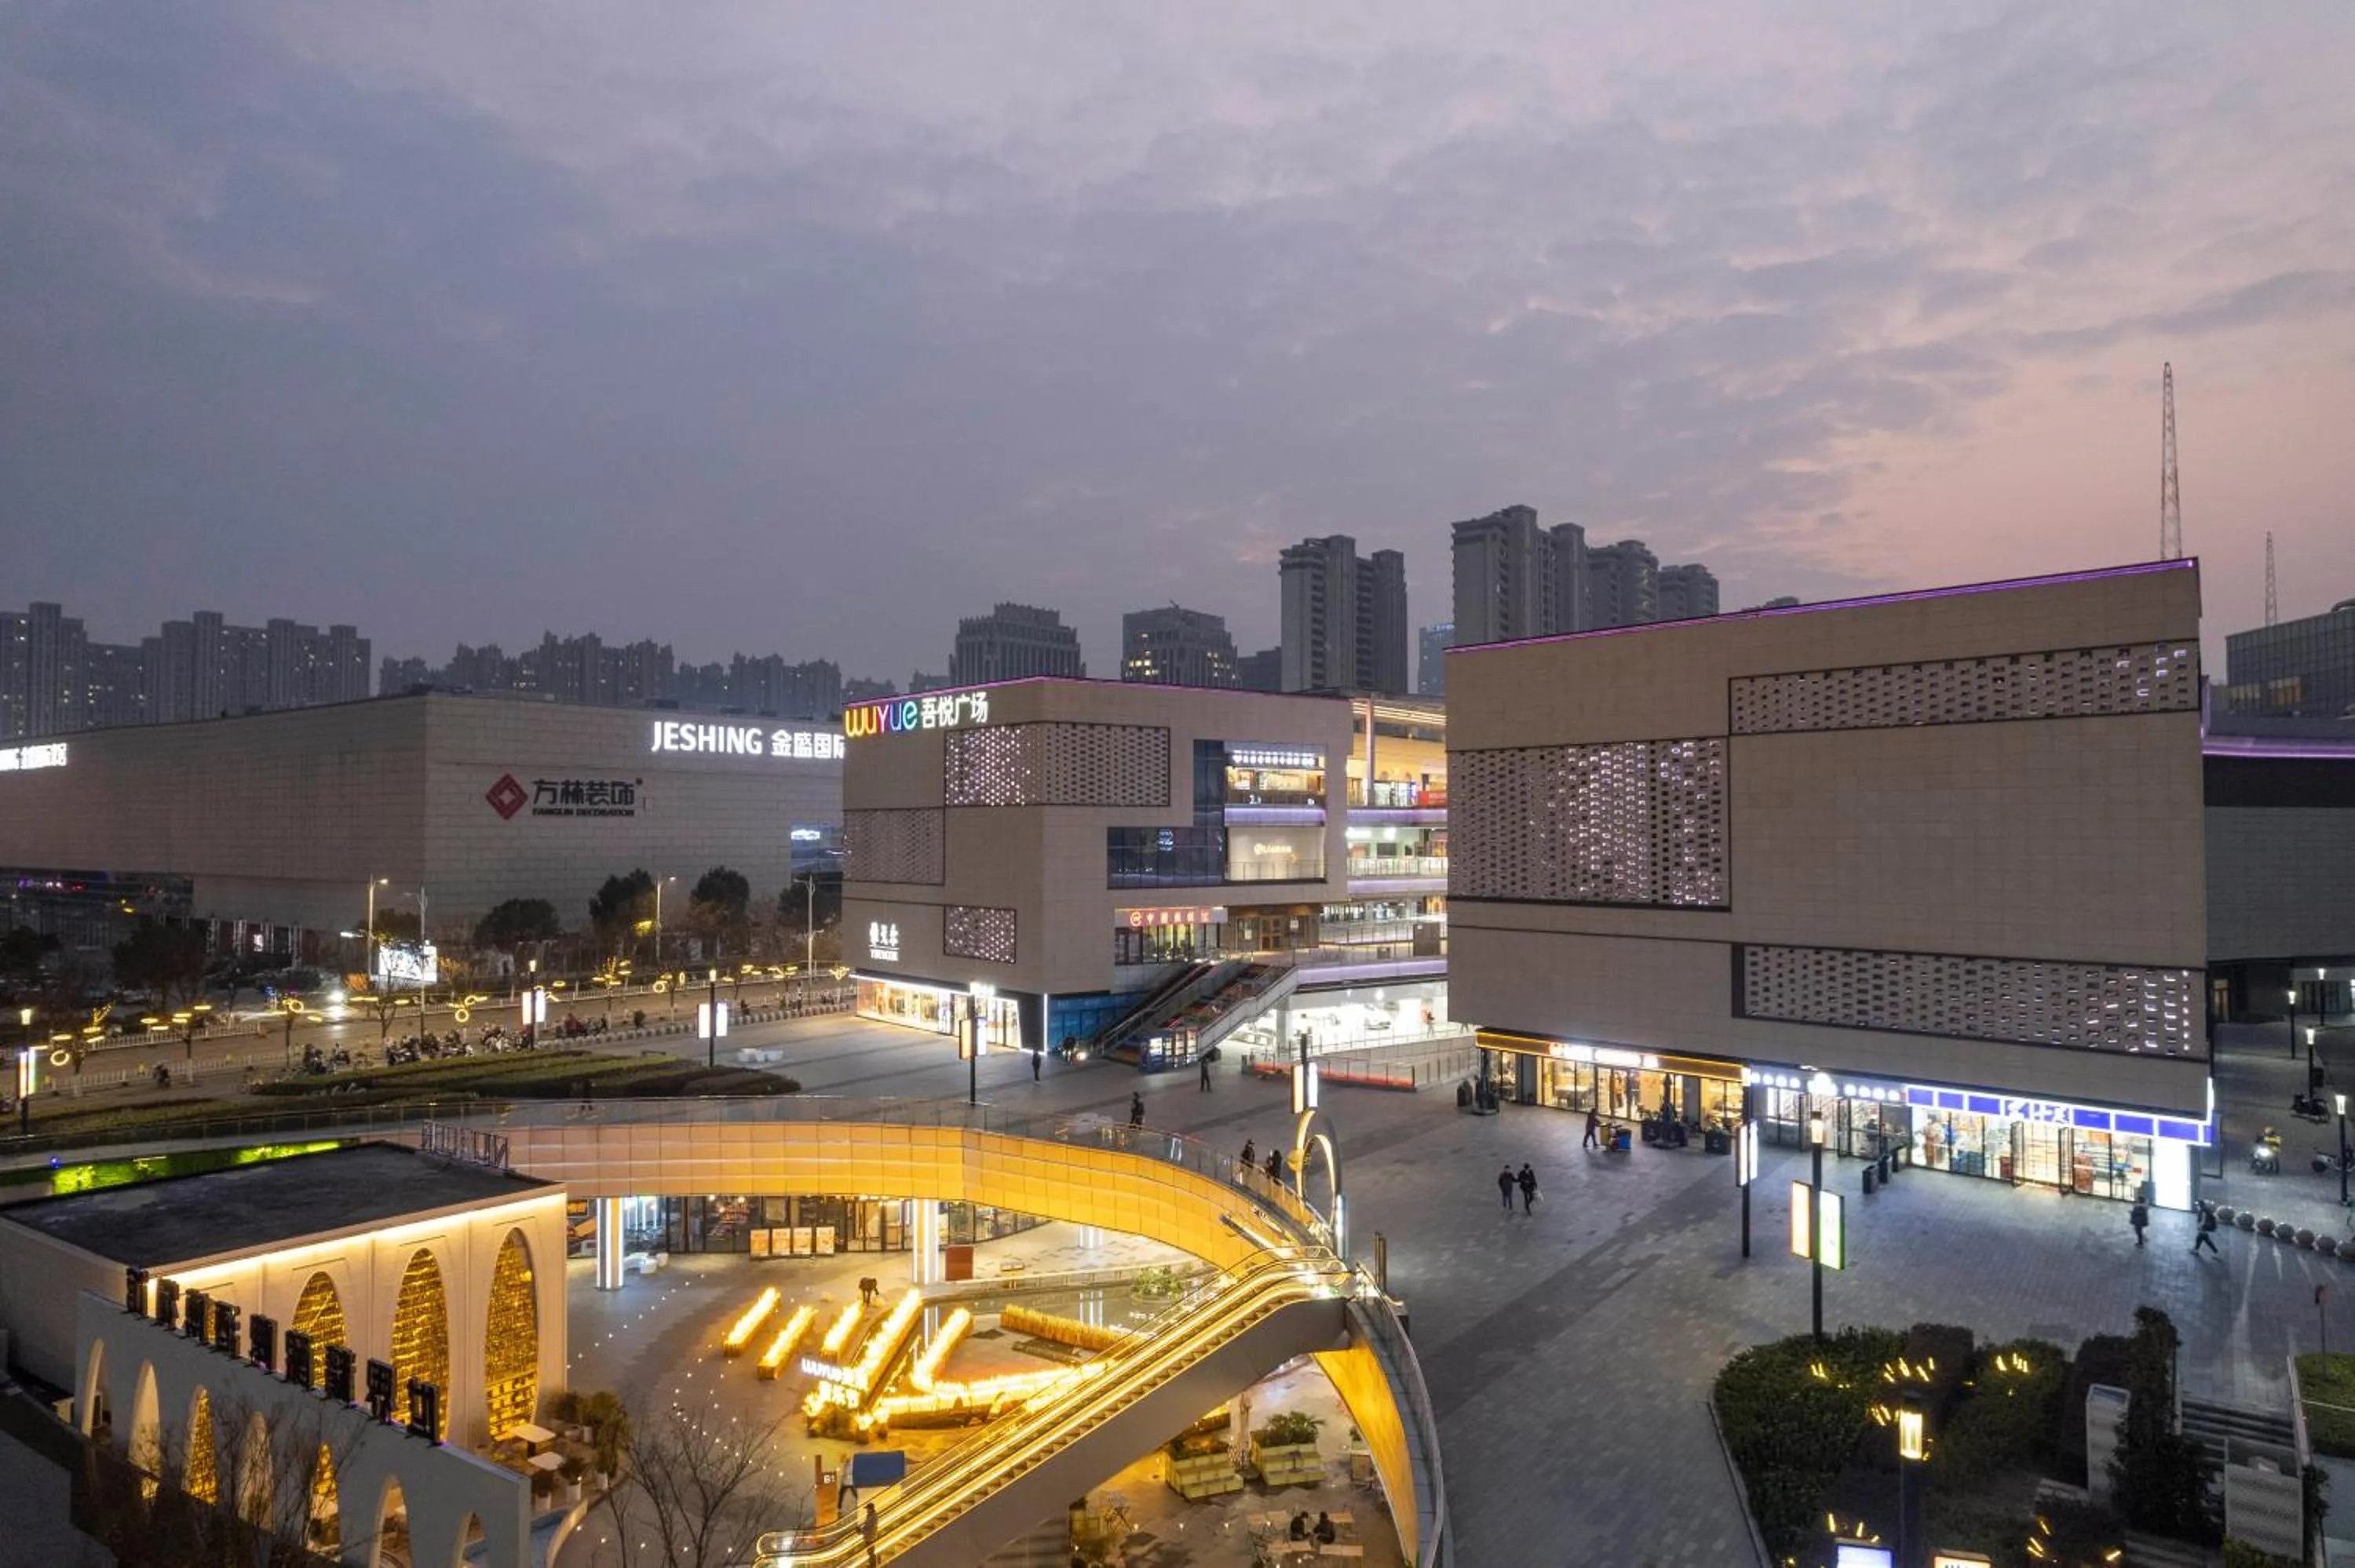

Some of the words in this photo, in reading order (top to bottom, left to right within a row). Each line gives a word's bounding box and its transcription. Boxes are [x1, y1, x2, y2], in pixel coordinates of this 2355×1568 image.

[921, 691, 989, 728] 吾悦广场
[652, 721, 762, 754] JESHING
[532, 779, 635, 805] 方林装饰
